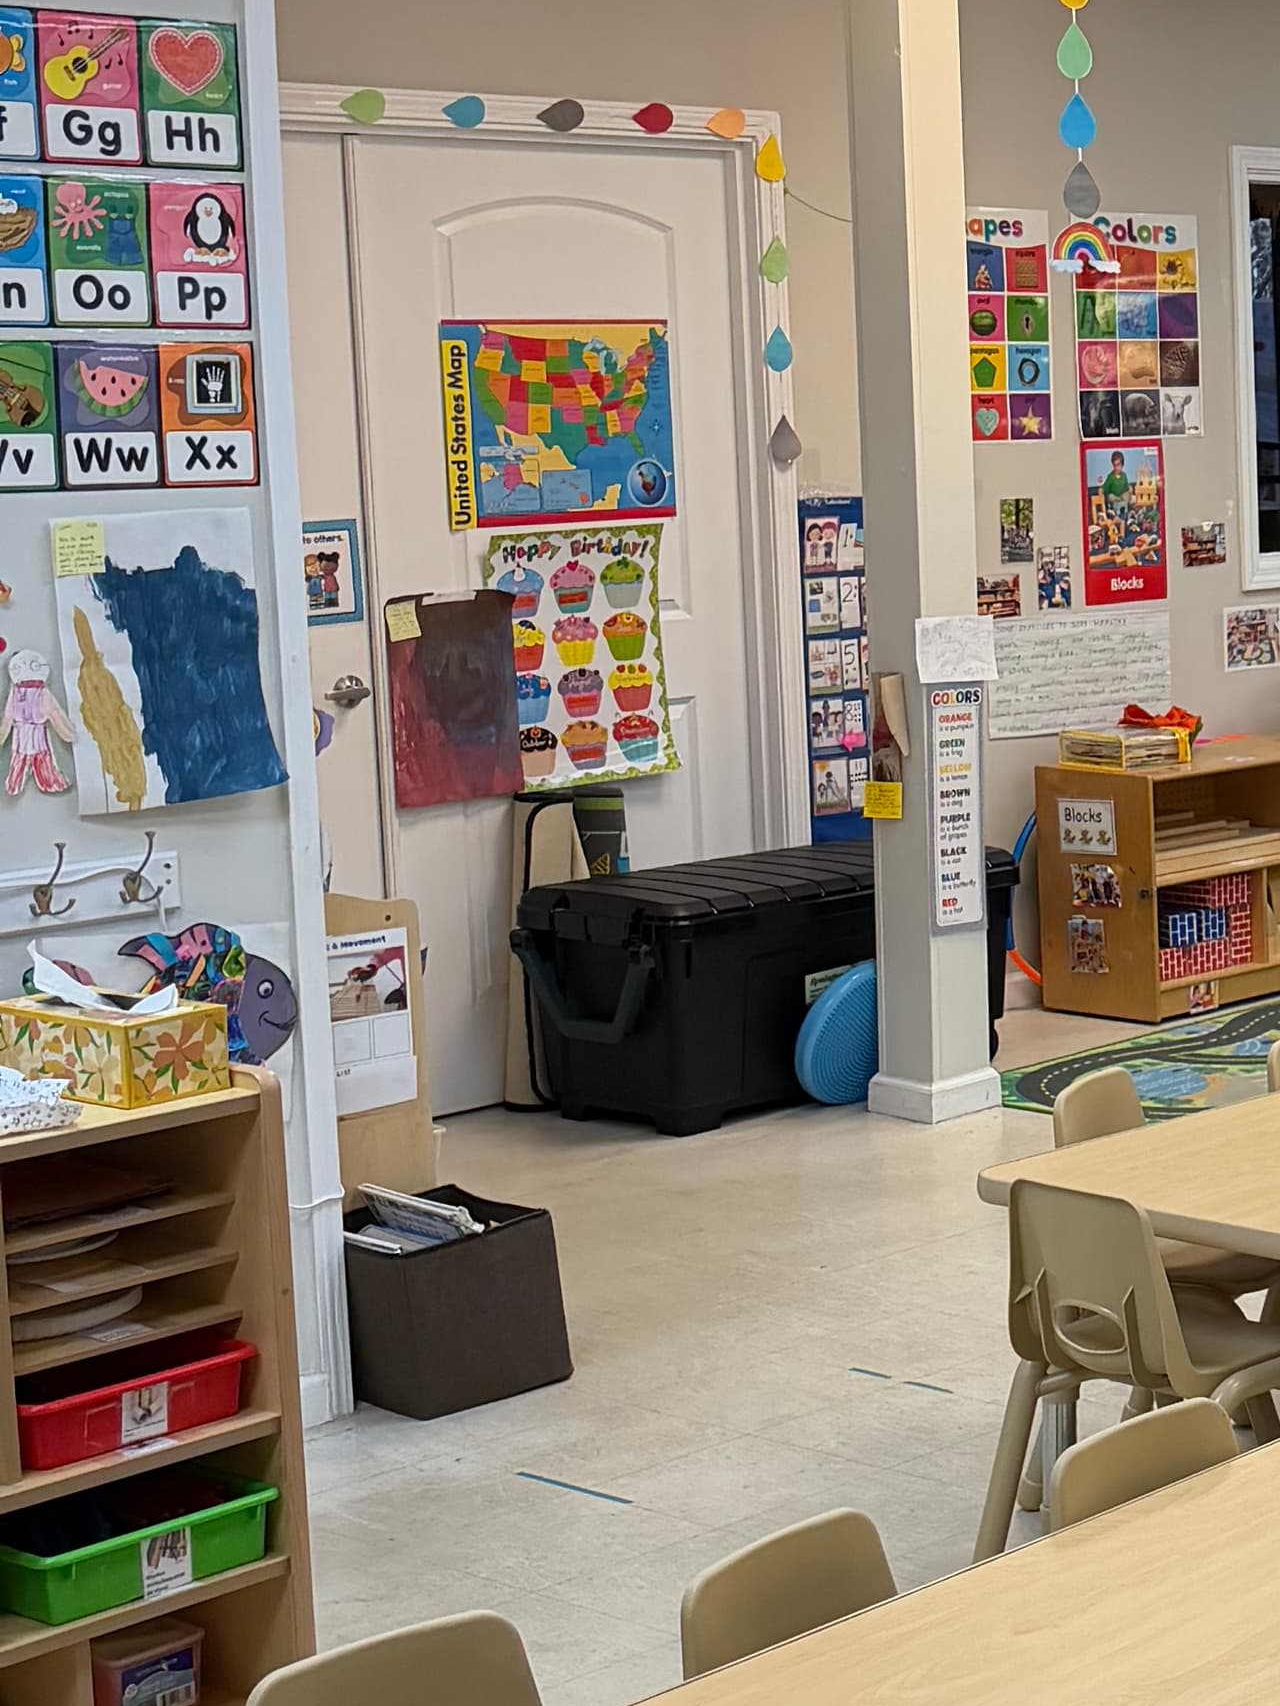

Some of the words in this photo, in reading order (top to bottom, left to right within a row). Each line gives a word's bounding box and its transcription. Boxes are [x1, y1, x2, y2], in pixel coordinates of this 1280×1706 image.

[63, 110, 122, 157] Gg
[165, 115, 220, 153] Hh
[73, 274, 131, 311] Oo
[178, 276, 226, 320] Pp
[448, 345, 467, 389] Map
[451, 394, 467, 455] States
[73, 438, 149, 473] Ww
[186, 436, 238, 470] Xx
[452, 461, 472, 524] United
[502, 541, 561, 564] Happy
[570, 536, 649, 558] Birthday!
[842, 582, 854, 603] 2
[1110, 576, 1145, 592] Blocks
[844, 644, 855, 666] 5
[933, 690, 980, 705] COLORS
[939, 713, 972, 723] ORANGE
[939, 739, 965, 749] GREEN
[939, 763, 972, 774] YELLOW
[940, 788, 971, 799] BROWN
[941, 813, 971, 824] PURPLE
[1064, 806, 1102, 823] Blocks
[941, 846, 967, 857] BLACK
[941, 871, 960, 882] BLUE
[942, 897, 958, 907] RED
[340, 935, 386, 948] Movement
